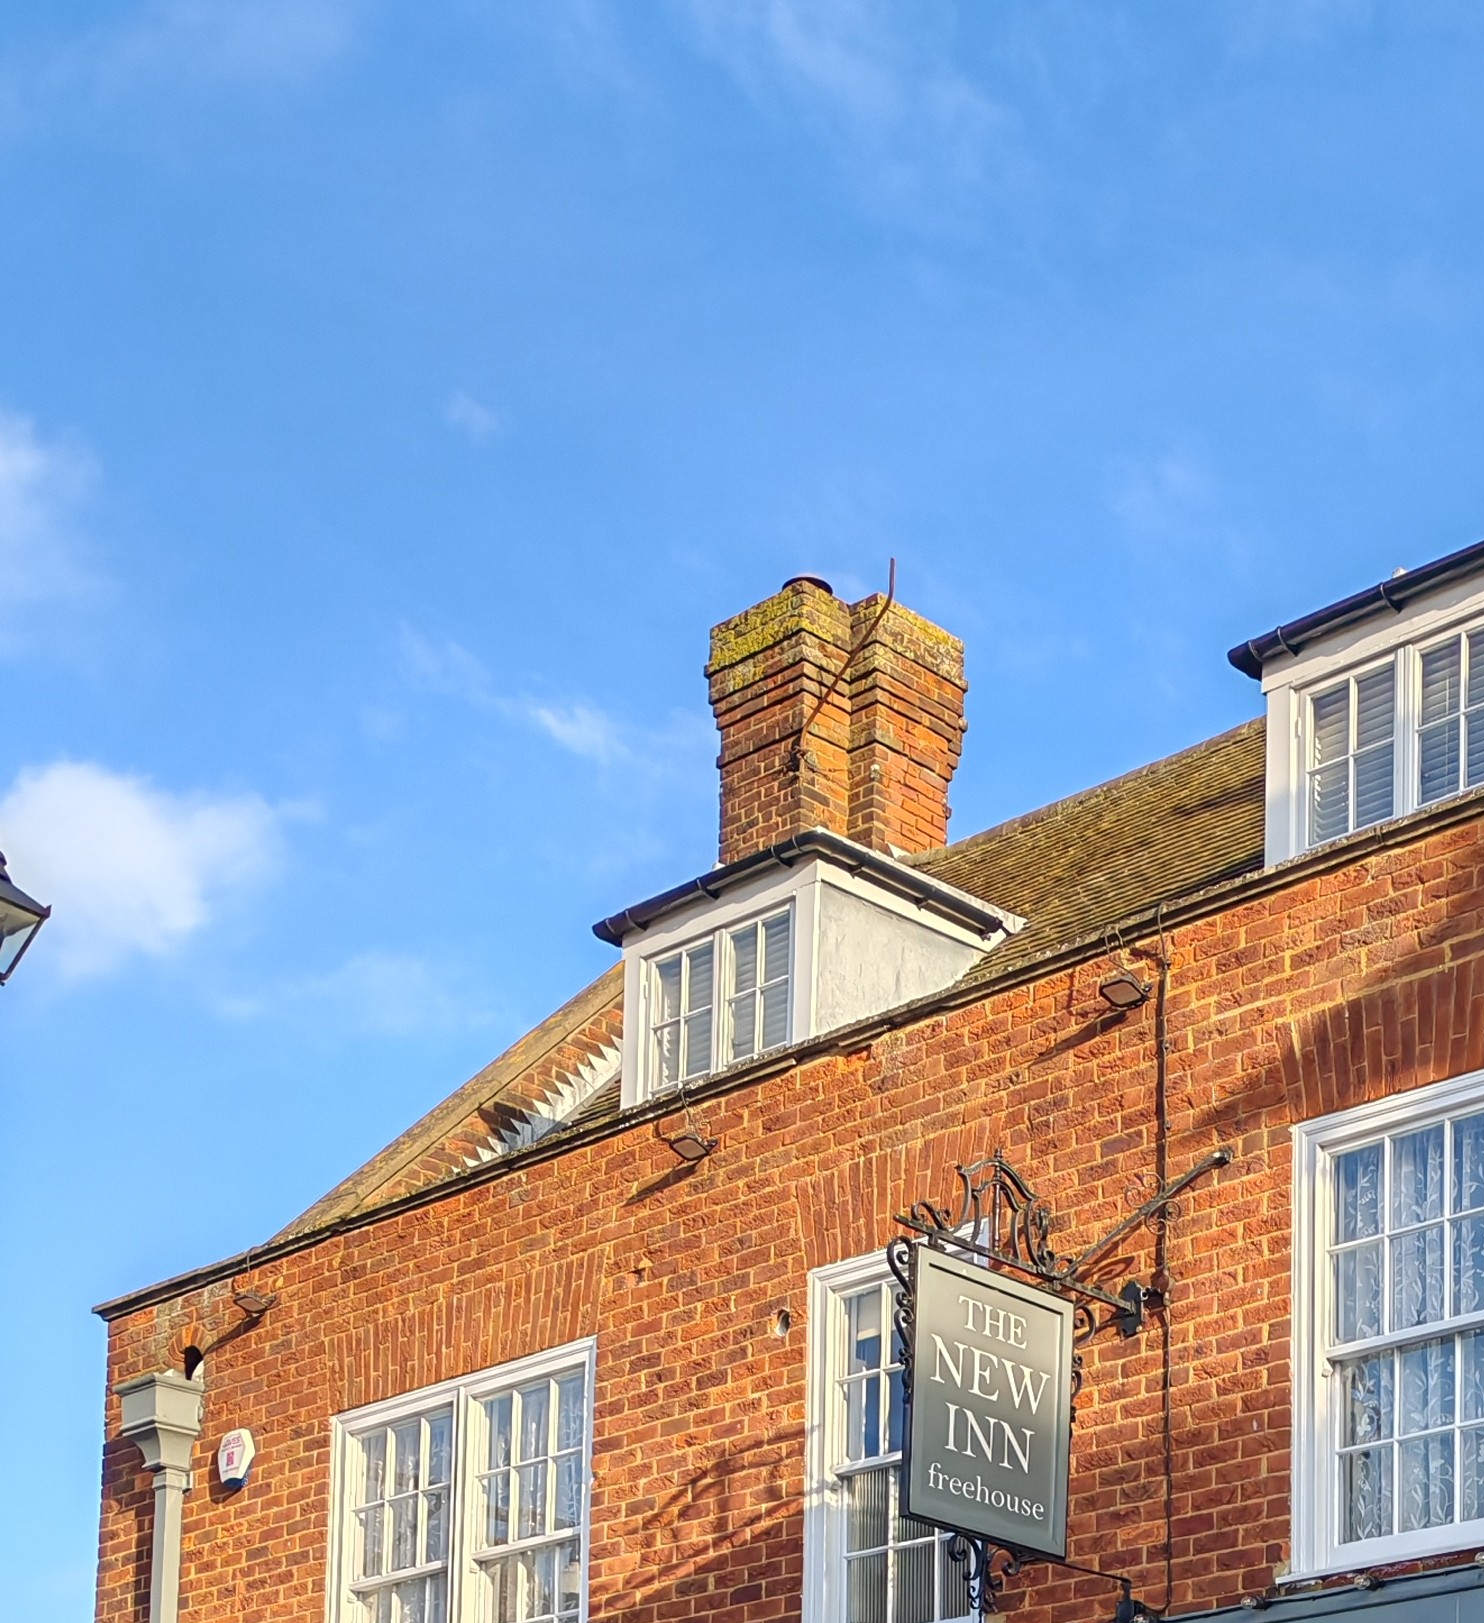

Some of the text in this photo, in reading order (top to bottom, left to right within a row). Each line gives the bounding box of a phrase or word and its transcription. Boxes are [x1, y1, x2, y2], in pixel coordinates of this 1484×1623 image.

[957, 1295, 1028, 1350] THE
[930, 1333, 1051, 1415] NEW
[944, 1402, 1035, 1475] INN
[927, 1462, 1045, 1521] freehouse
